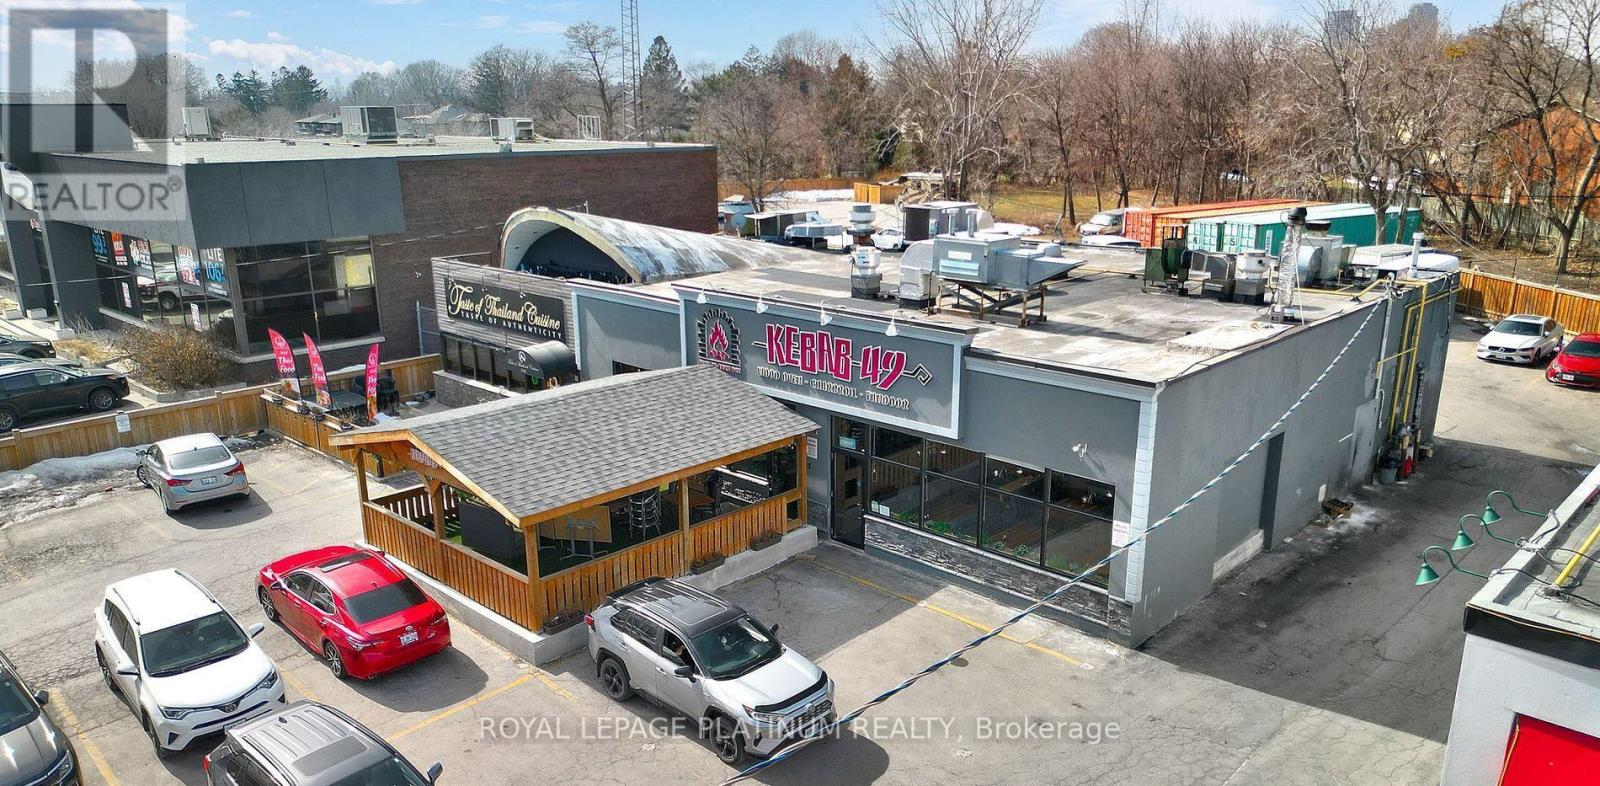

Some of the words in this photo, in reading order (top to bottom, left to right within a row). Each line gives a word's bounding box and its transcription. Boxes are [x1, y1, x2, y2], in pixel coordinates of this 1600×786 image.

[448, 284, 474, 315] Taste
[475, 298, 484, 318] of
[484, 294, 524, 322] Thailand
[524, 301, 561, 330] Cuisine
[461, 311, 484, 322] TASTE
[488, 317, 498, 325] OF
[502, 320, 562, 339] AUTHENTICITY
[766, 324, 852, 382] KEBAB
[860, 346, 907, 390] 49
[757, 366, 781, 380] WOOD
[865, 390, 910, 410] TANDOOR
